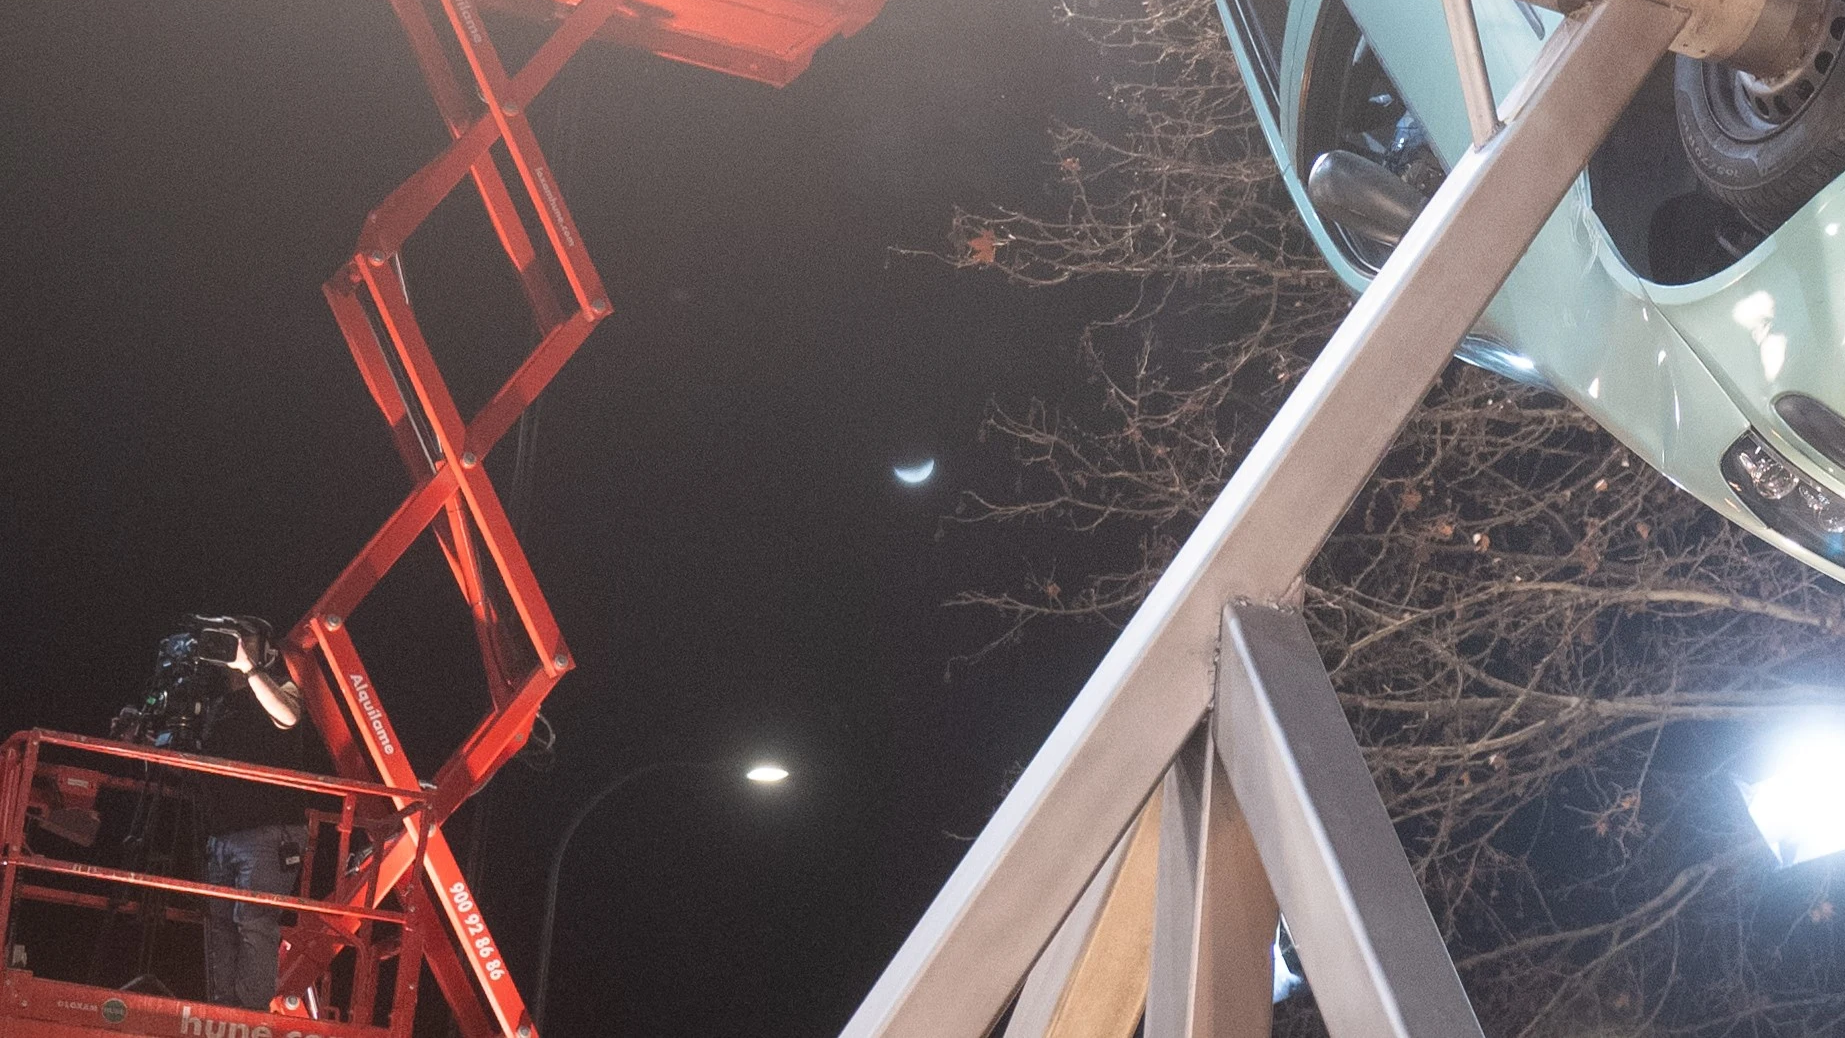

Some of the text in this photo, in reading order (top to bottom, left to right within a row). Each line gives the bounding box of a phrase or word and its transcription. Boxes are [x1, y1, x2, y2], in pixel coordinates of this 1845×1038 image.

[535, 166, 575, 247] loxamhune.com
[449, 881, 505, 981] 900 92 86 86
